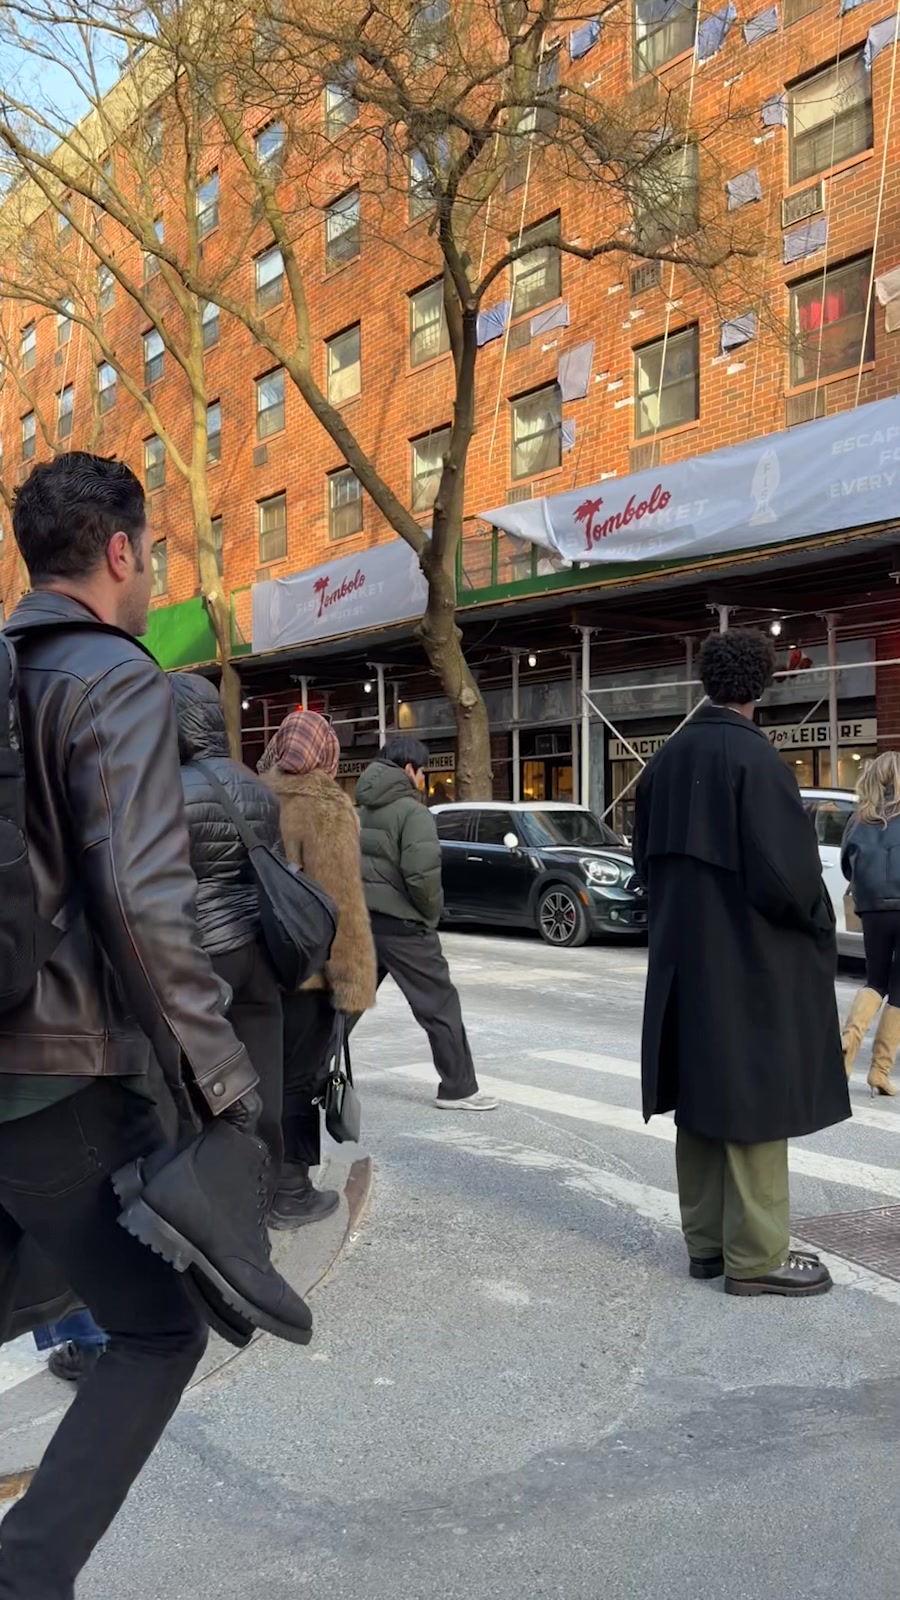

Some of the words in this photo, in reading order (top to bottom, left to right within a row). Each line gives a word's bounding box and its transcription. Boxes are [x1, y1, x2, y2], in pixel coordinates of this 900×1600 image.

[572, 484, 672, 551] Tombolo
[312, 569, 366, 618] Tombolo
[616, 740, 665, 756] INACTI
